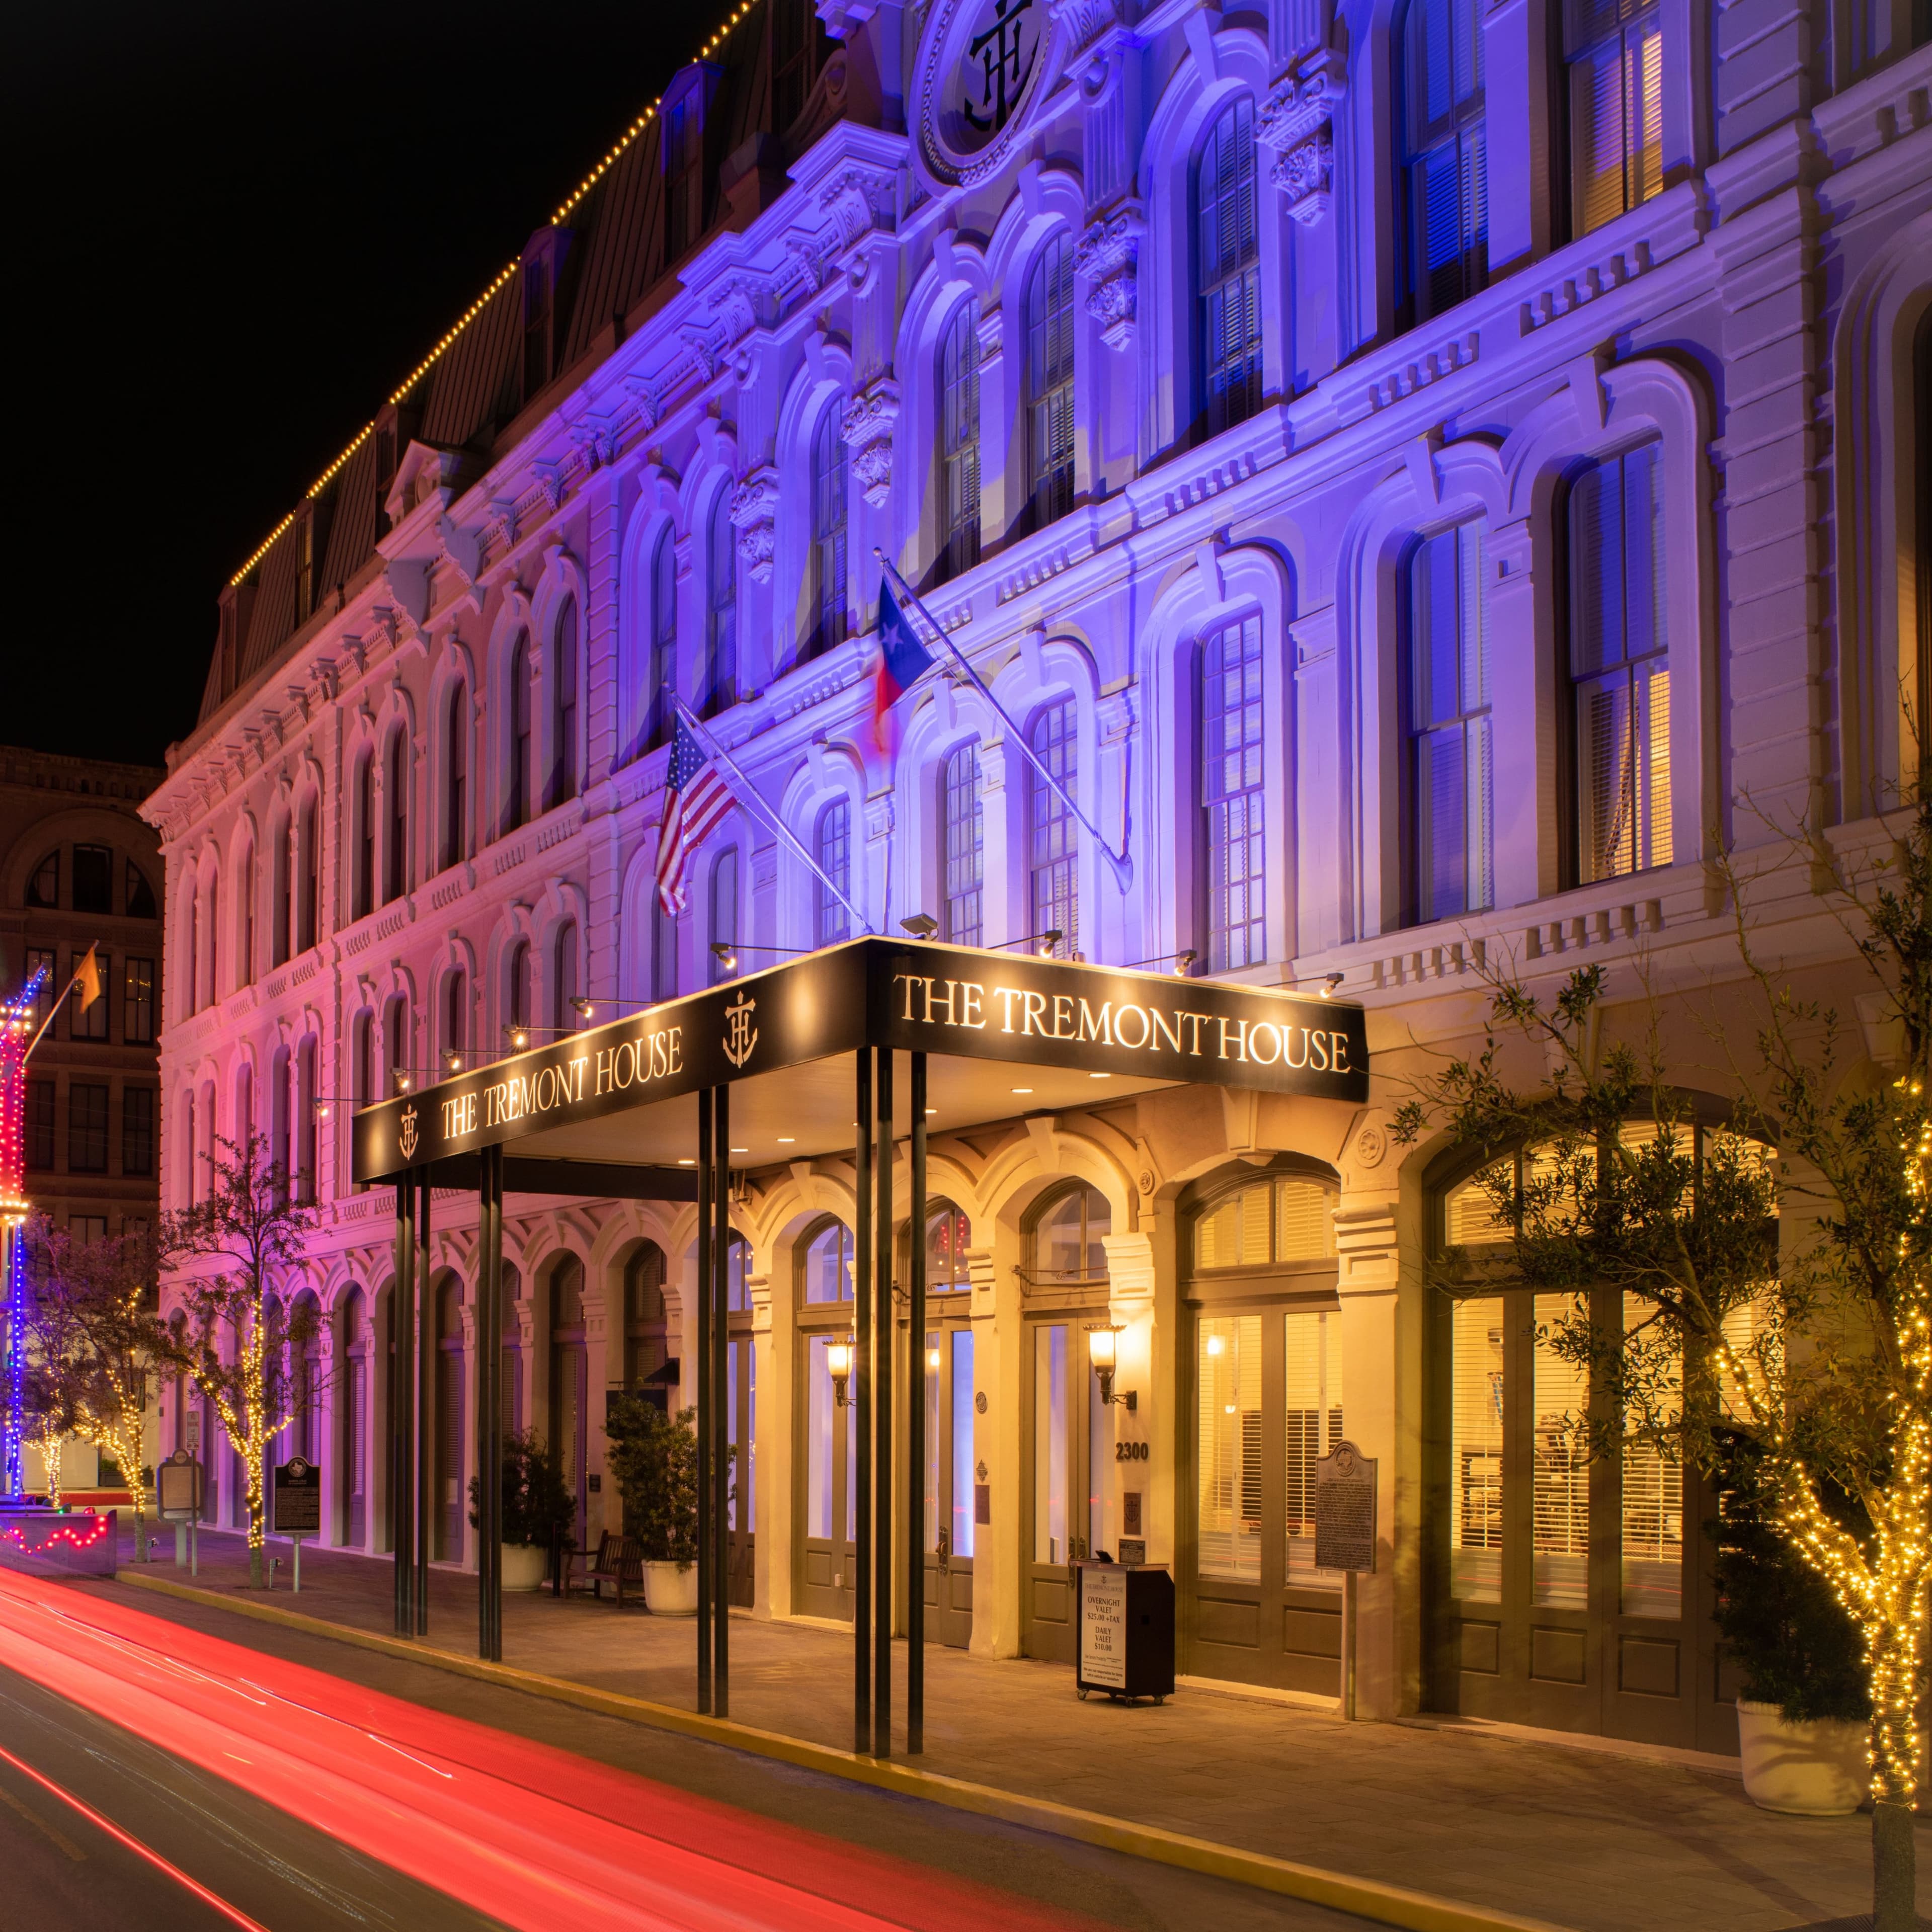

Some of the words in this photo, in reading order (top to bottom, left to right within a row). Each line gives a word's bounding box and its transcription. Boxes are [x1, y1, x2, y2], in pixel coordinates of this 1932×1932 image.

[893, 975, 986, 1028] THE
[994, 987, 1212, 1056] TREMONT
[1218, 1017, 1351, 1074] HOUSE
[441, 1092, 477, 1139] THE
[484, 1057, 588, 1127] TREMONT
[595, 1026, 683, 1096] HOUSE
[1115, 1442, 1149, 1461] 2300
[1087, 1596, 1120, 1606] OVERNIGHT
[1096, 1605, 1111, 1614] VALET
[1087, 1612, 1105, 1621] $25.00
[1095, 1626, 1111, 1635] DAILY
[1095, 1635, 1111, 1643] VALET
[1094, 1643, 1112, 1651] $10.00
